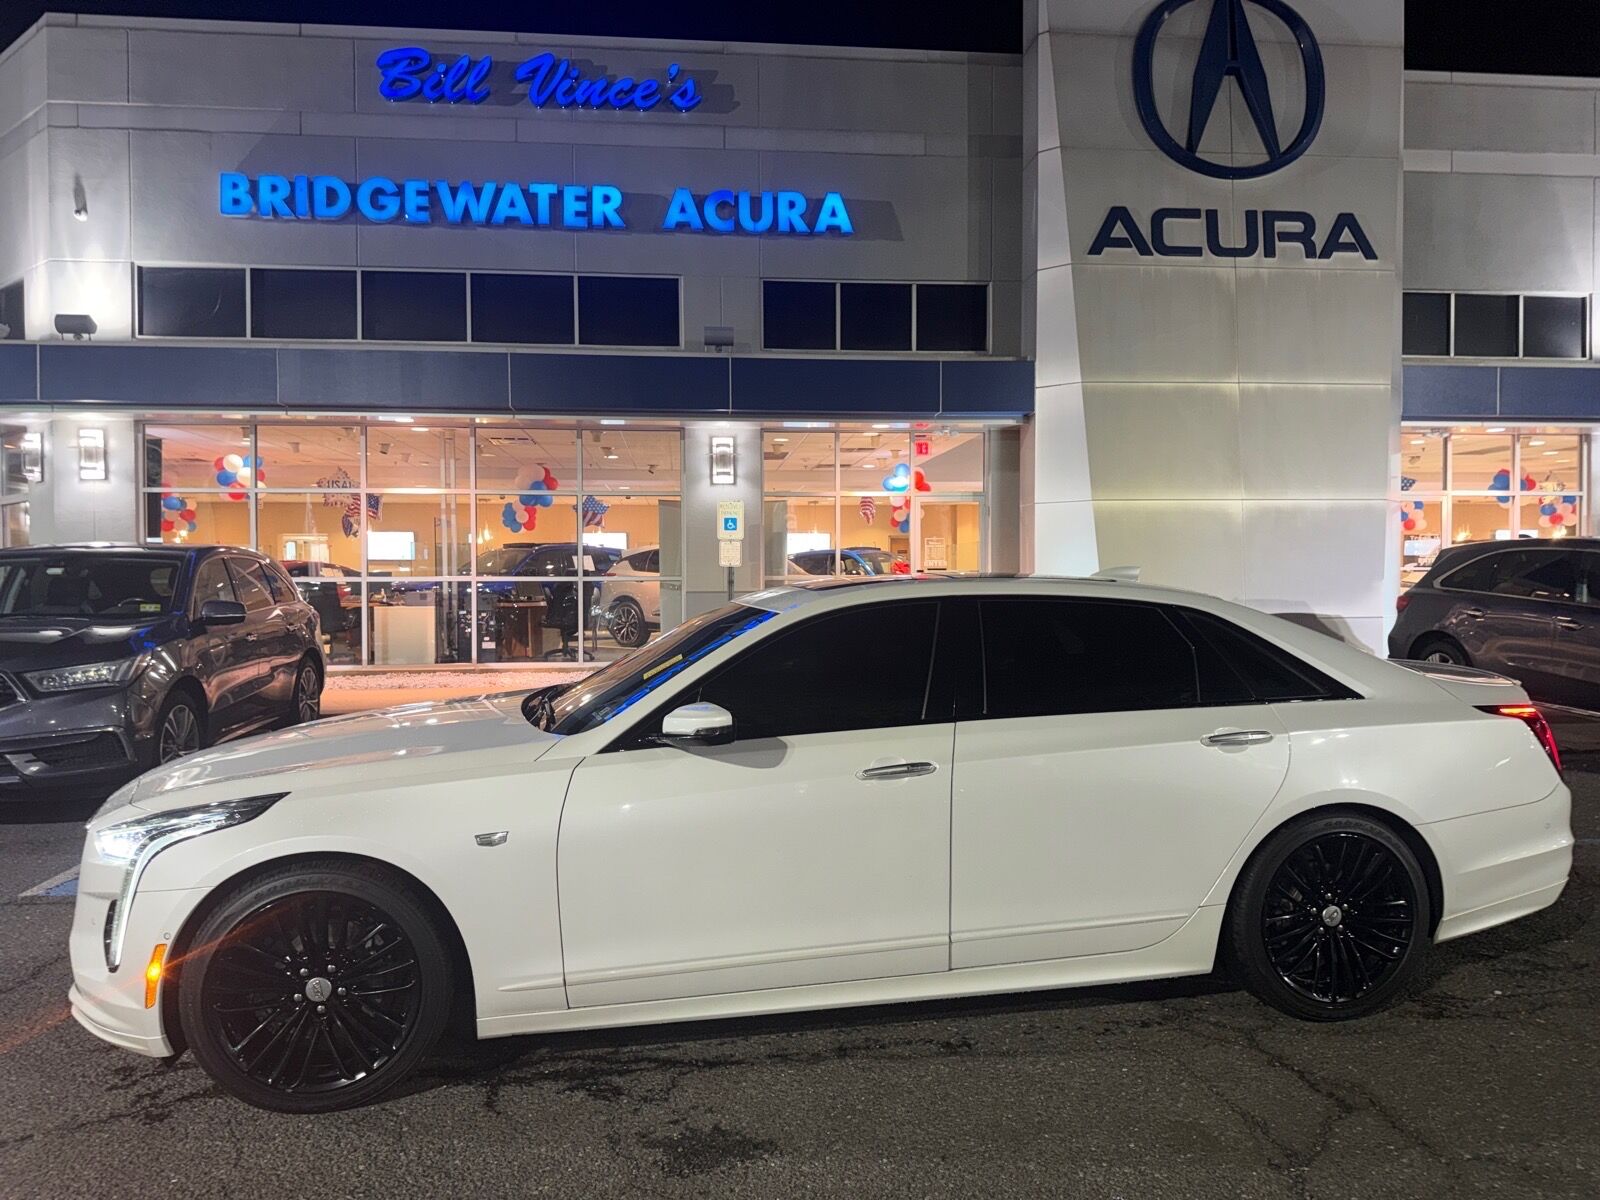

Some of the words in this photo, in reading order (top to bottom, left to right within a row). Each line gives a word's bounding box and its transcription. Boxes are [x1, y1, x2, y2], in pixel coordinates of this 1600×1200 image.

[376, 47, 493, 104] Bill
[514, 52, 701, 112] Vince's
[219, 171, 625, 230] BRIDGEWATER
[662, 188, 855, 236] ACURA
[1087, 206, 1378, 260] ACURA
